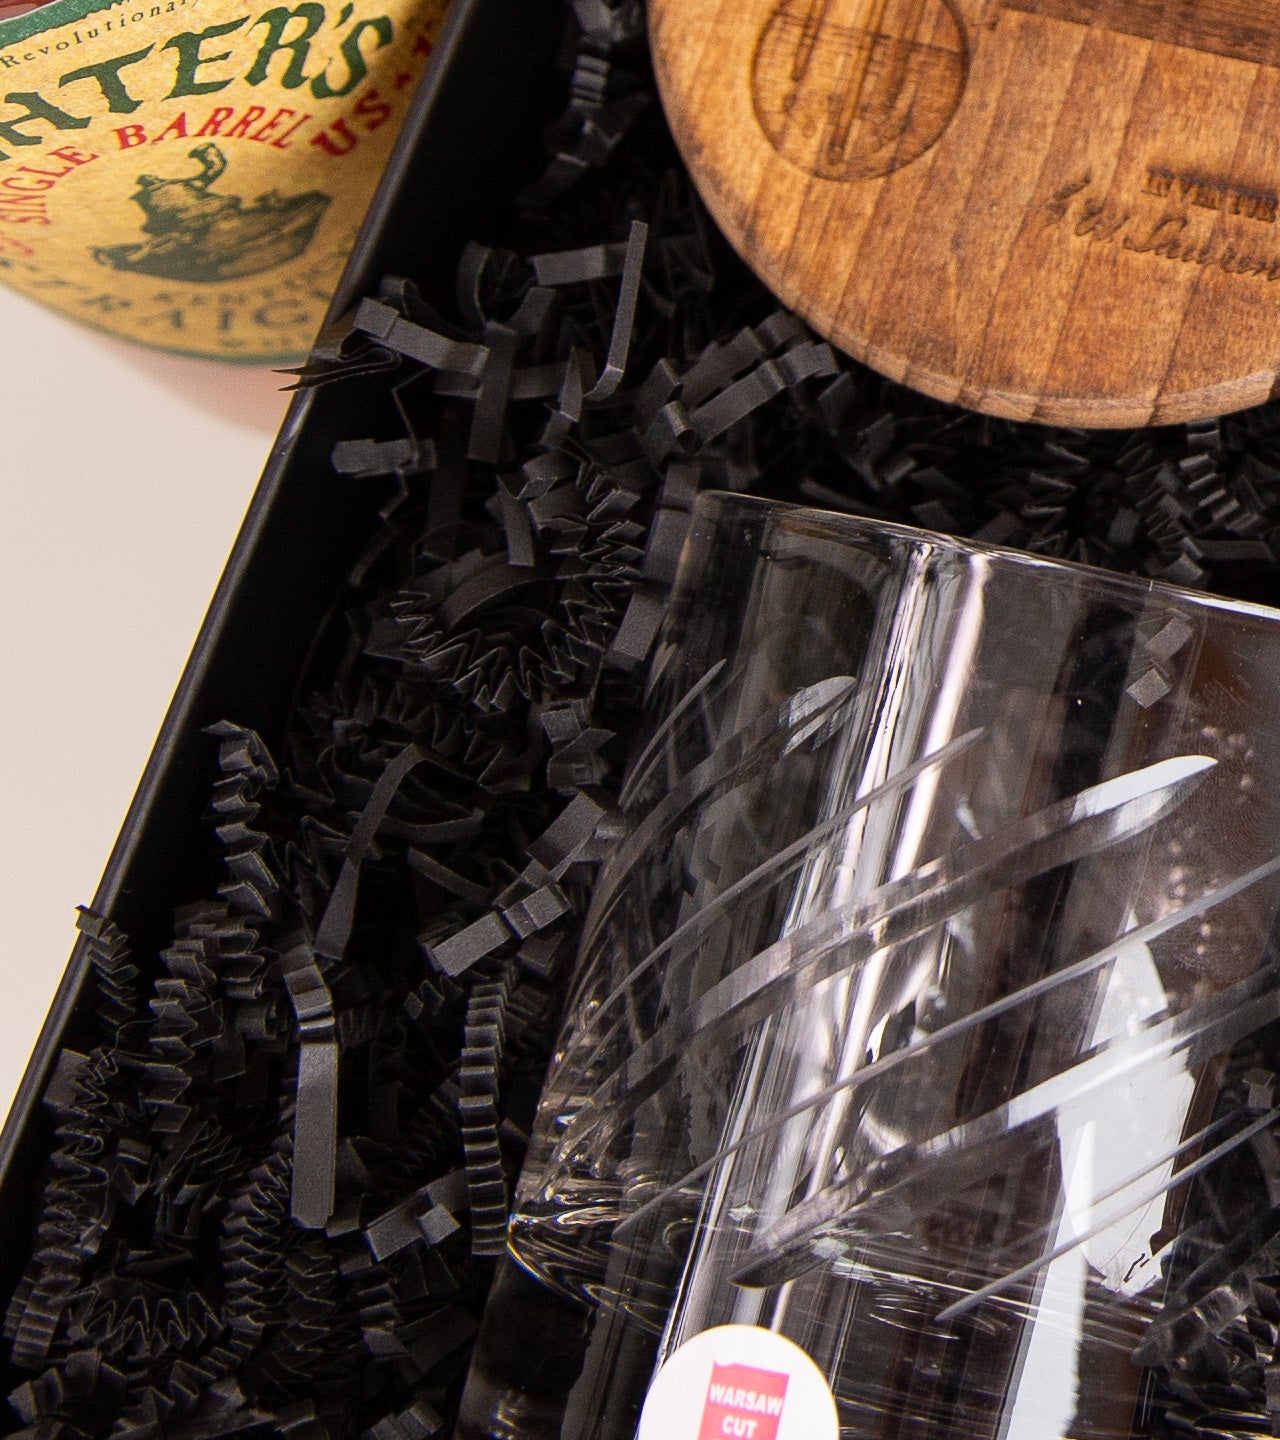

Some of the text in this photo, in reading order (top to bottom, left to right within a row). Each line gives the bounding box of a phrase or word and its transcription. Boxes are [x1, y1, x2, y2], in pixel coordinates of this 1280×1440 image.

[0, 145, 100, 227] SINGLE
[113, 105, 312, 150] BARREL
[708, 1383, 783, 1416] WARSAW
[722, 1416, 758, 1438] CUT
